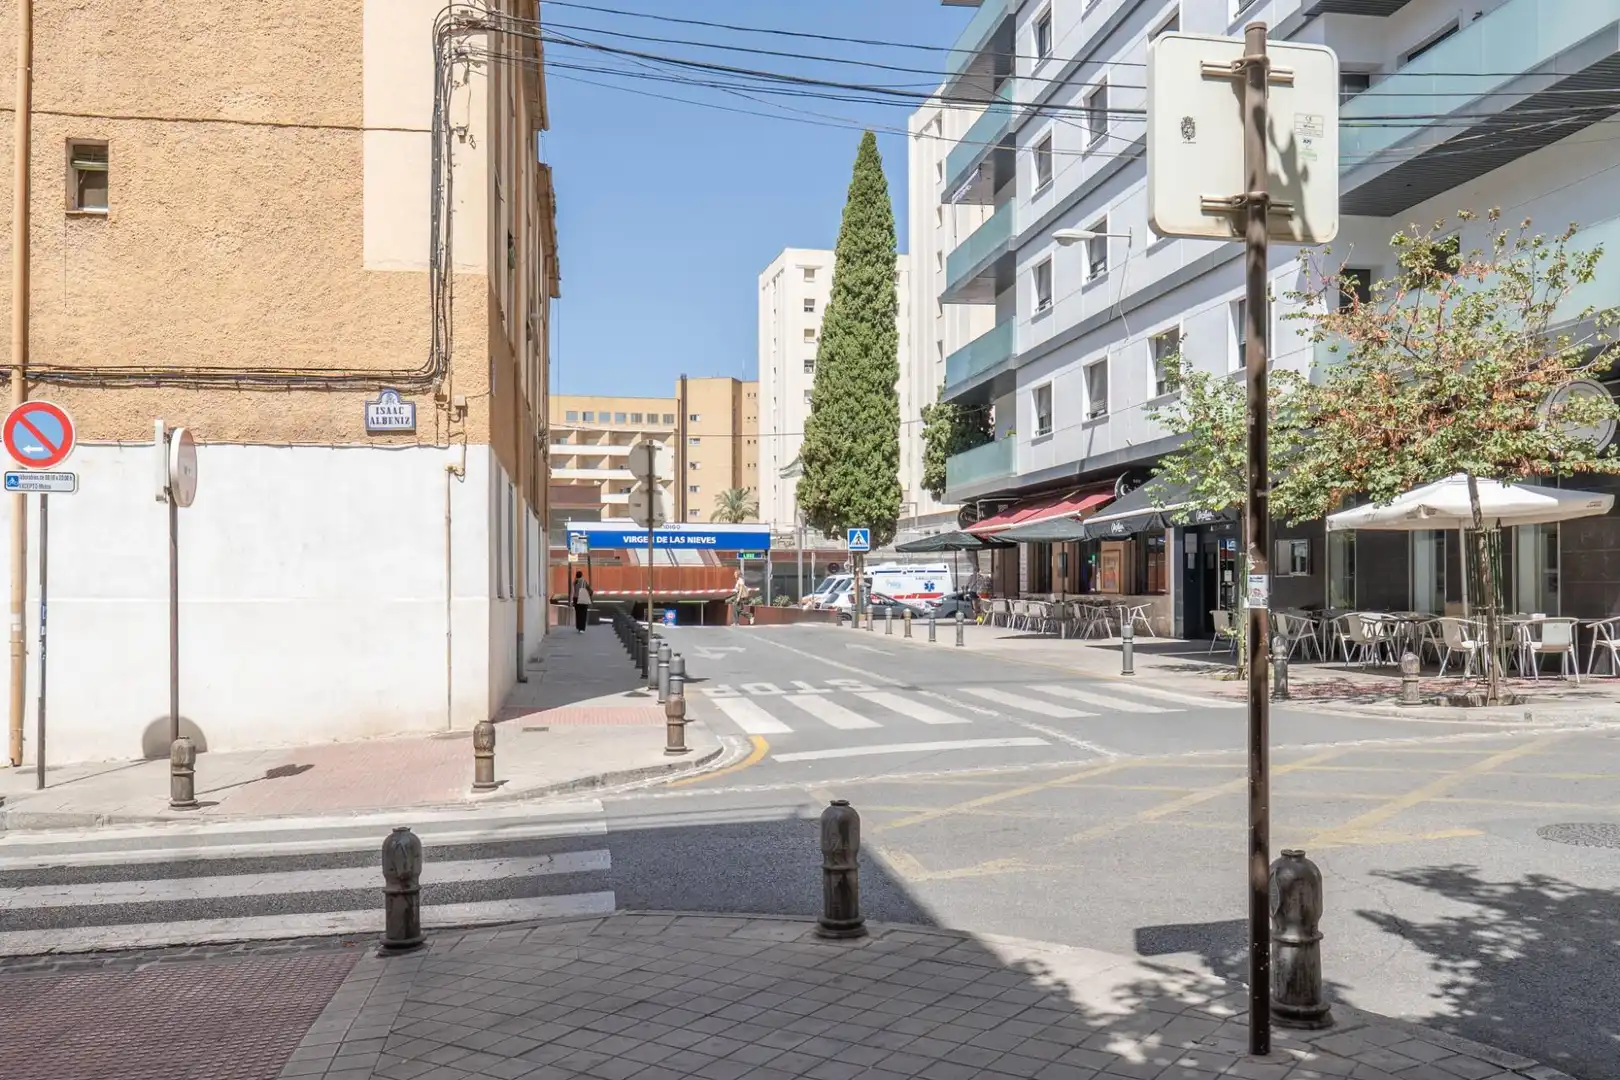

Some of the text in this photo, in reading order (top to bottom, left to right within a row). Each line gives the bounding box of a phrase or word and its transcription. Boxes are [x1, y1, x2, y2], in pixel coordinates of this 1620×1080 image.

[376, 406, 404, 415] ISAAC
[370, 416, 411, 425] ALBENIZ
[656, 536, 668, 544] DE
[669, 536, 686, 544] LAS
[687, 536, 717, 545] NIEVES
[701, 678, 879, 697] STOP
